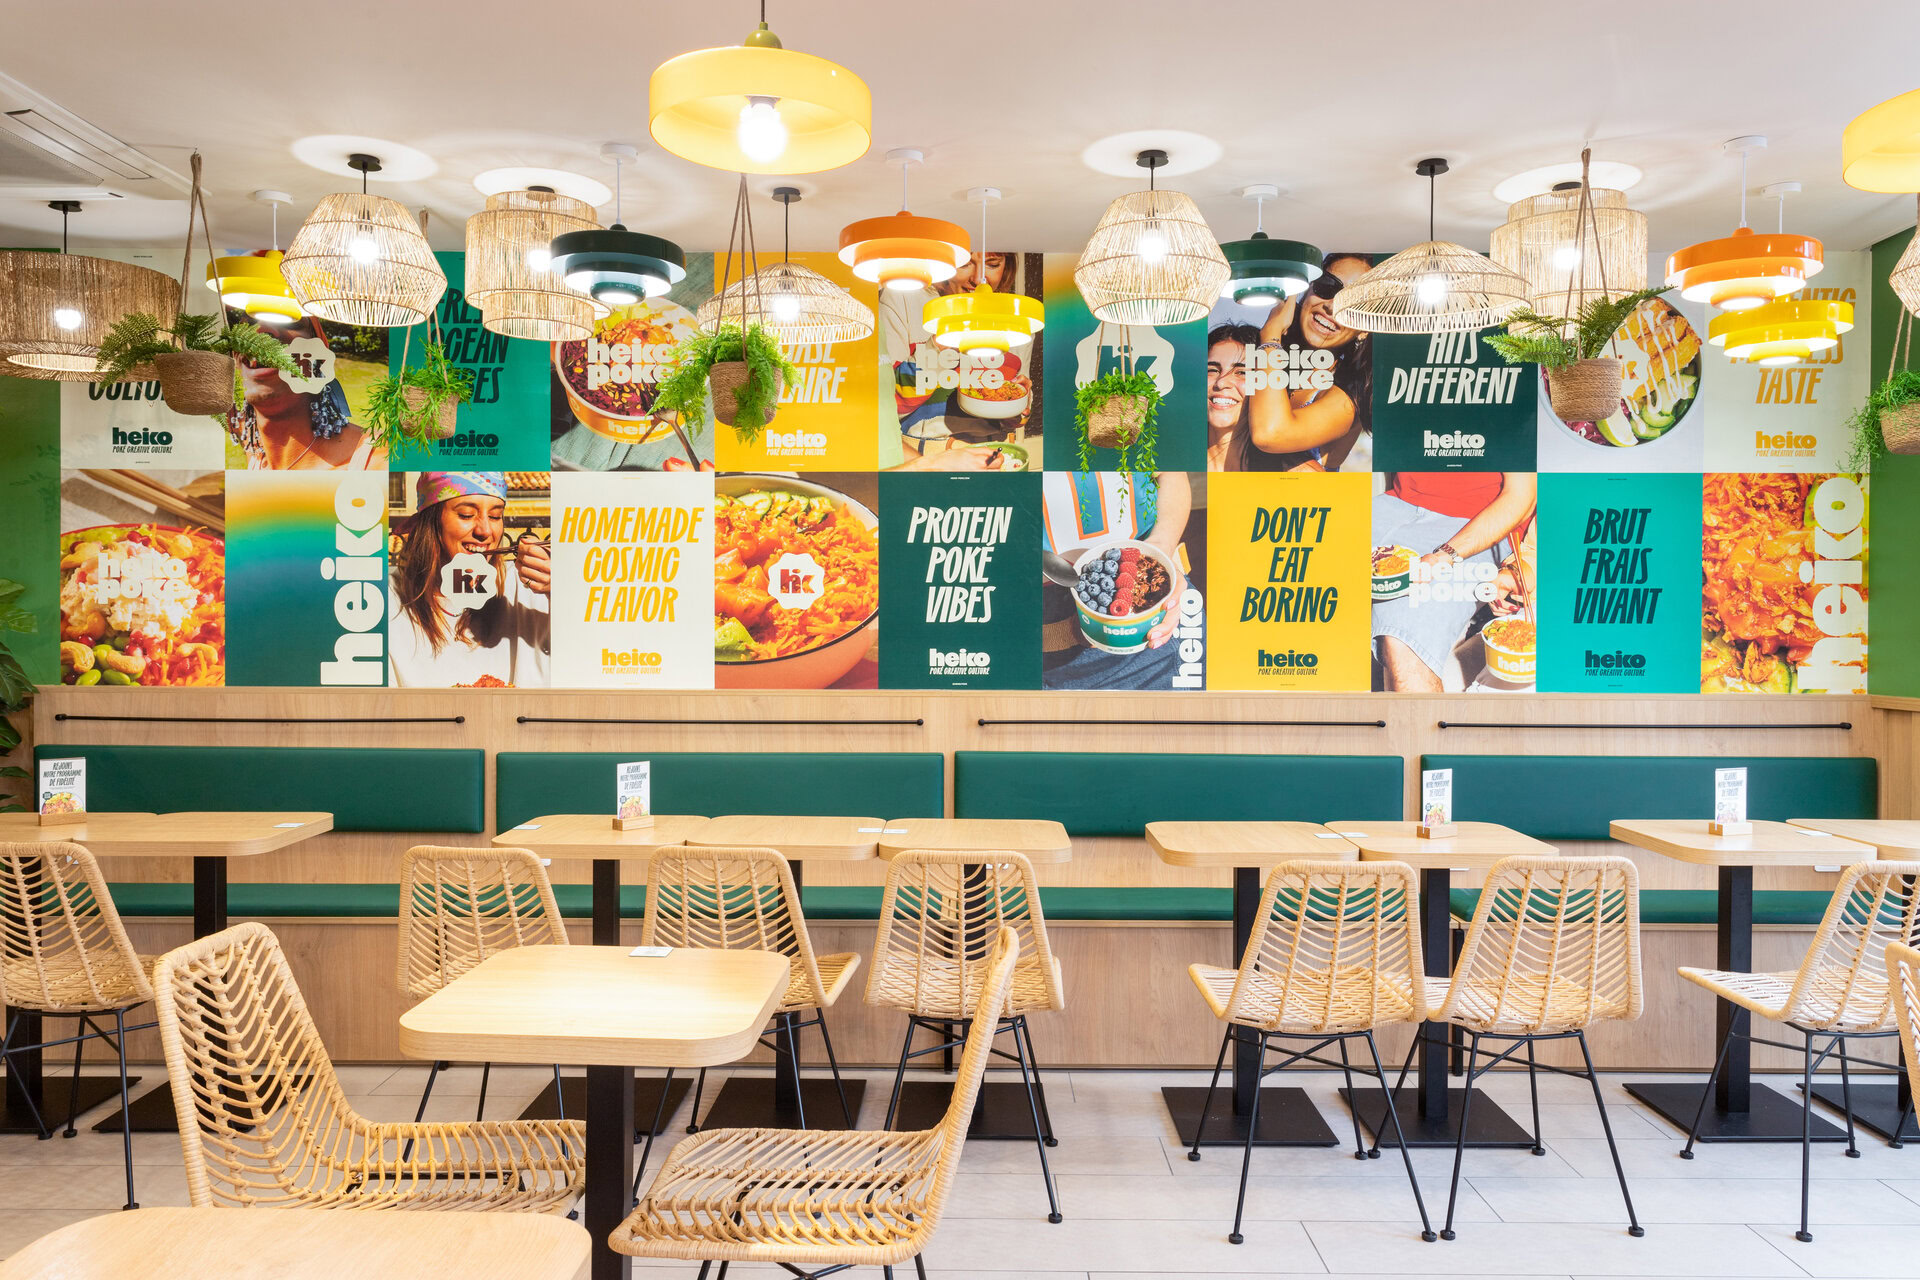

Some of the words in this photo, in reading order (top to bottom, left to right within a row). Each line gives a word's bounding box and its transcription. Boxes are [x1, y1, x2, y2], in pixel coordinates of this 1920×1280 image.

[587, 338, 677, 363] heiko
[1245, 344, 1335, 369] heiko
[1426, 329, 1482, 364] HITS
[777, 367, 848, 403] LAIRE
[916, 369, 1005, 395] poke
[1245, 369, 1335, 395] poke
[1387, 367, 1522, 404] DIFFERENT
[1755, 368, 1824, 404] TASTE
[112, 427, 173, 445] heiko
[608, 421, 668, 436] heio
[766, 430, 827, 448] heiko
[1424, 430, 1485, 449] heiko
[1756, 431, 1817, 449] heiko
[559, 507, 705, 543] HOMEMADE
[907, 506, 1013, 544] PROTEIN
[1250, 507, 1331, 543] DON'T
[1583, 508, 1652, 544] BRUT
[98, 552, 188, 578] heiko
[320, 474, 385, 685] heiko
[583, 546, 680, 583] COSMIC
[925, 543, 995, 583] POKÉ
[1267, 547, 1314, 583] EAT
[1409, 556, 1499, 581] heiko
[1580, 548, 1653, 584] FRAIS
[1409, 582, 1499, 608] poke
[1797, 477, 1865, 689] heiko
[584, 586, 679, 622] FLAVOR
[925, 586, 996, 623] VIBES
[1239, 586, 1338, 623] BORING
[1573, 588, 1663, 624] VIVANT
[1103, 625, 1138, 636] heiko
[1172, 588, 1204, 688] heiko
[601, 648, 662, 667] heiko
[929, 648, 990, 667] heiko
[1258, 649, 1318, 667] heiko
[1498, 655, 1536, 673] heik
[1585, 650, 1646, 669] heiko
